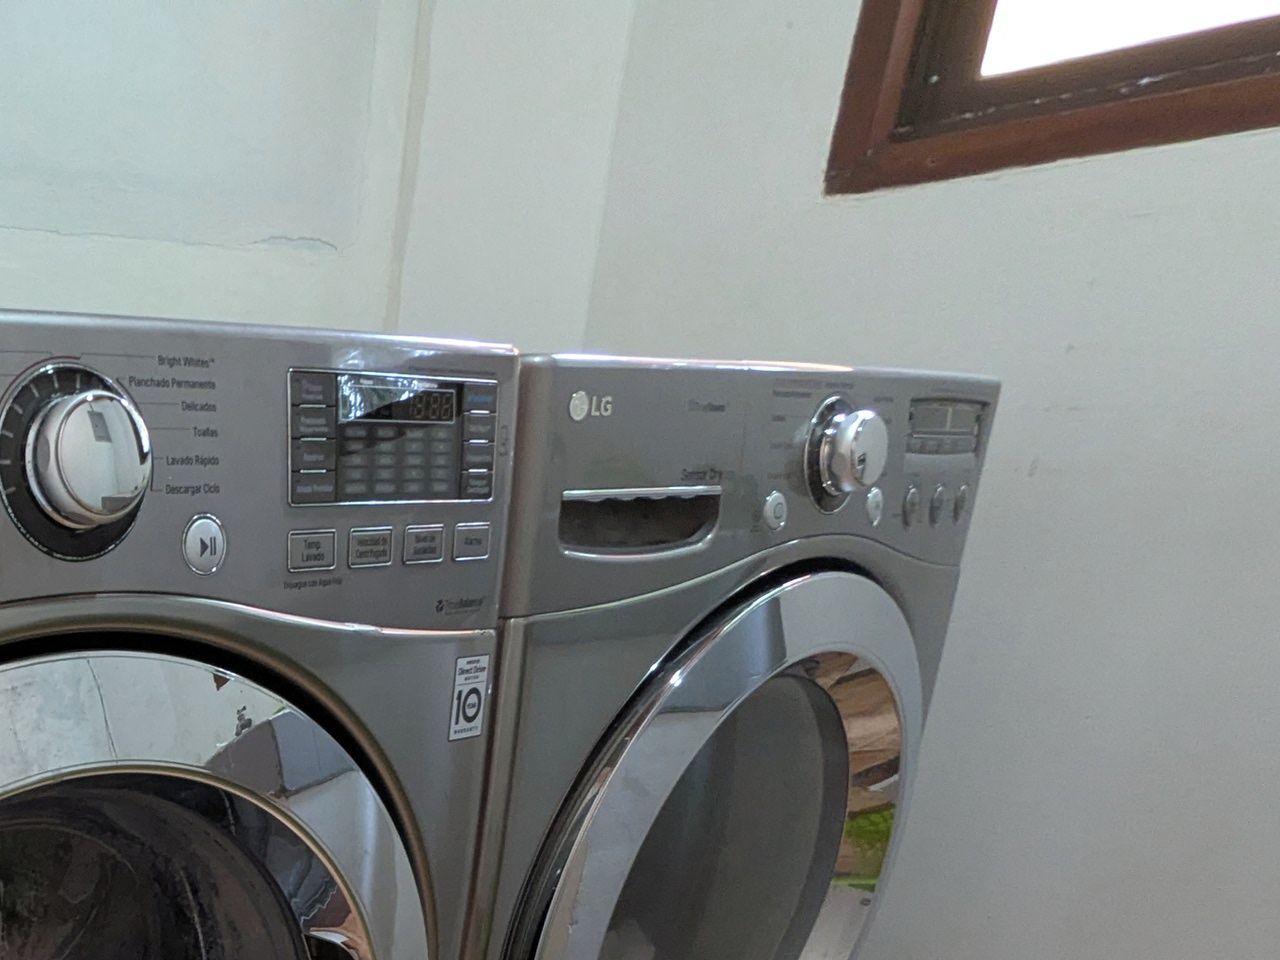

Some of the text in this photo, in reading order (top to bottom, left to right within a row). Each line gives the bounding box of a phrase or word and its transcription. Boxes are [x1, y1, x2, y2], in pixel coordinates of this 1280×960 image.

[128, 375, 170, 388] Planchado
[591, 396, 613, 416] LG
[166, 455, 194, 466] Lavado
[455, 687, 482, 725] 10
